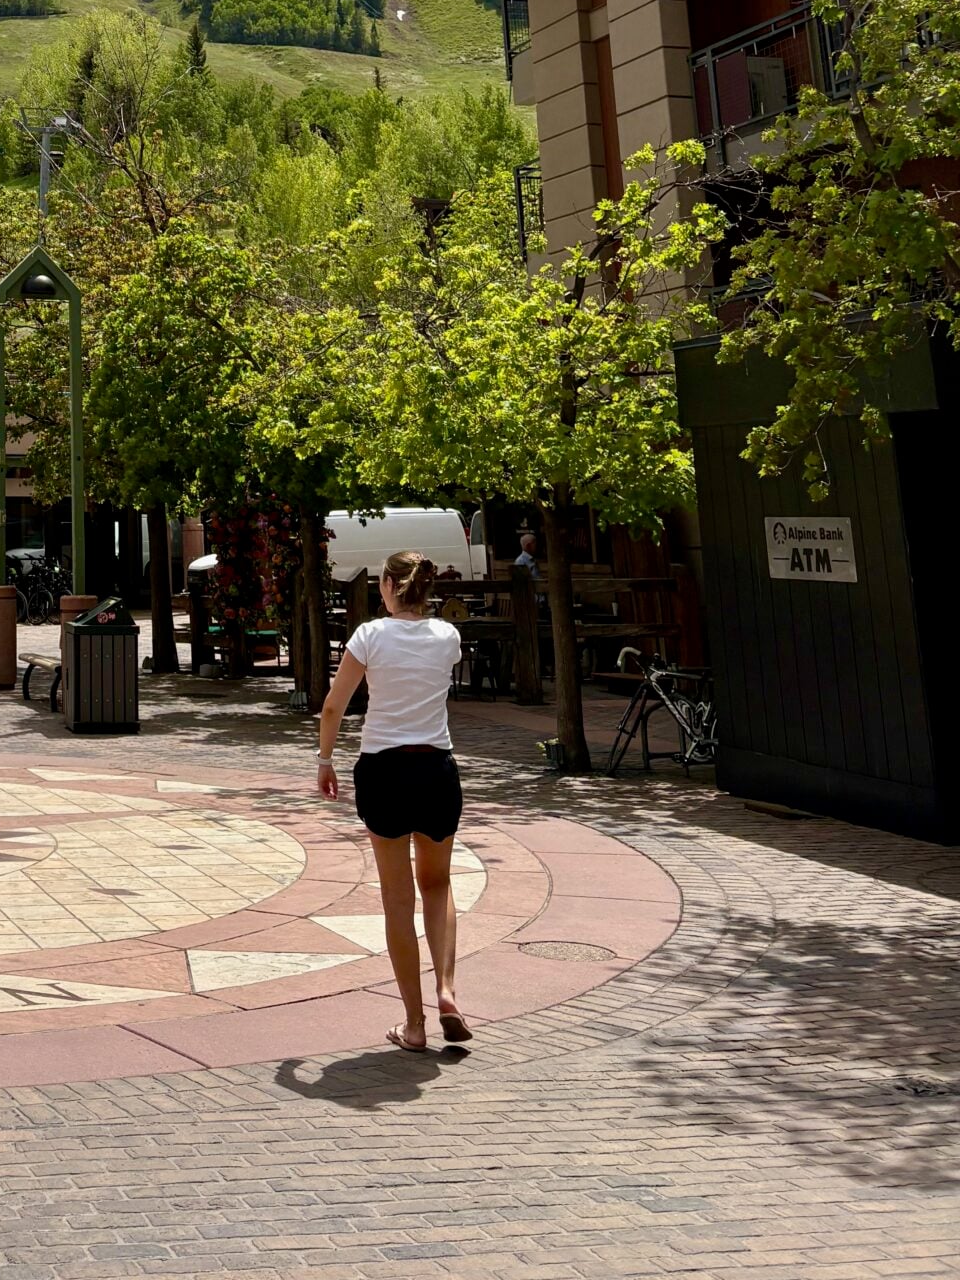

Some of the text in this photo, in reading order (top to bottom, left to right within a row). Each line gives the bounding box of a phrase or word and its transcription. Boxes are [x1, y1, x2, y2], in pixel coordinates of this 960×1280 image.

[788, 526, 844, 542] Alpine Bank
[790, 548, 832, 573] ATM
